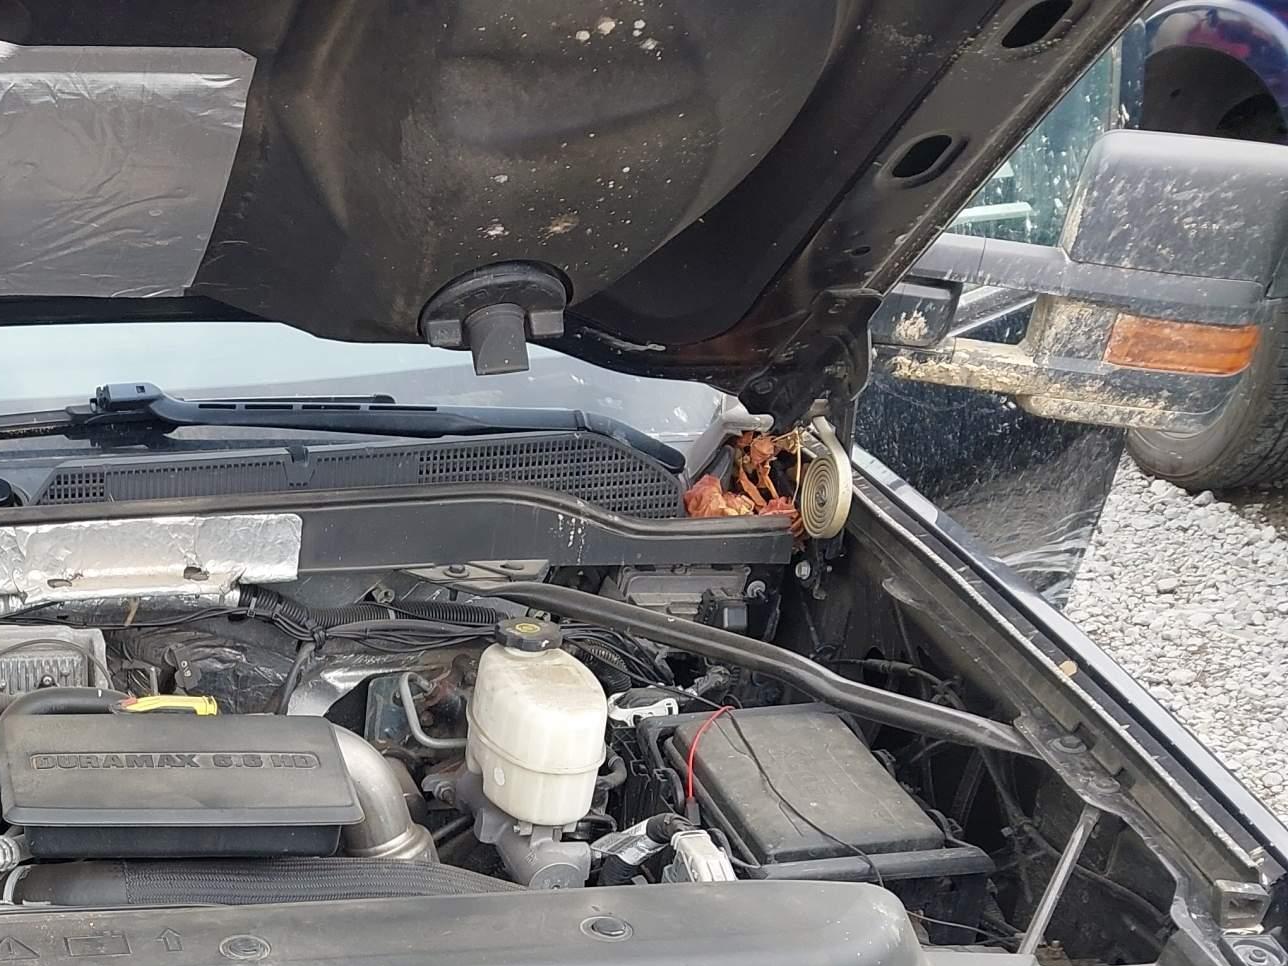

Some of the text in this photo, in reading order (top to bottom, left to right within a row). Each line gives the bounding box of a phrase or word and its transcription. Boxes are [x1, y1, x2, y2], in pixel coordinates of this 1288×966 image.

[33, 752, 310, 769] DURAMAX 6.6 HD
